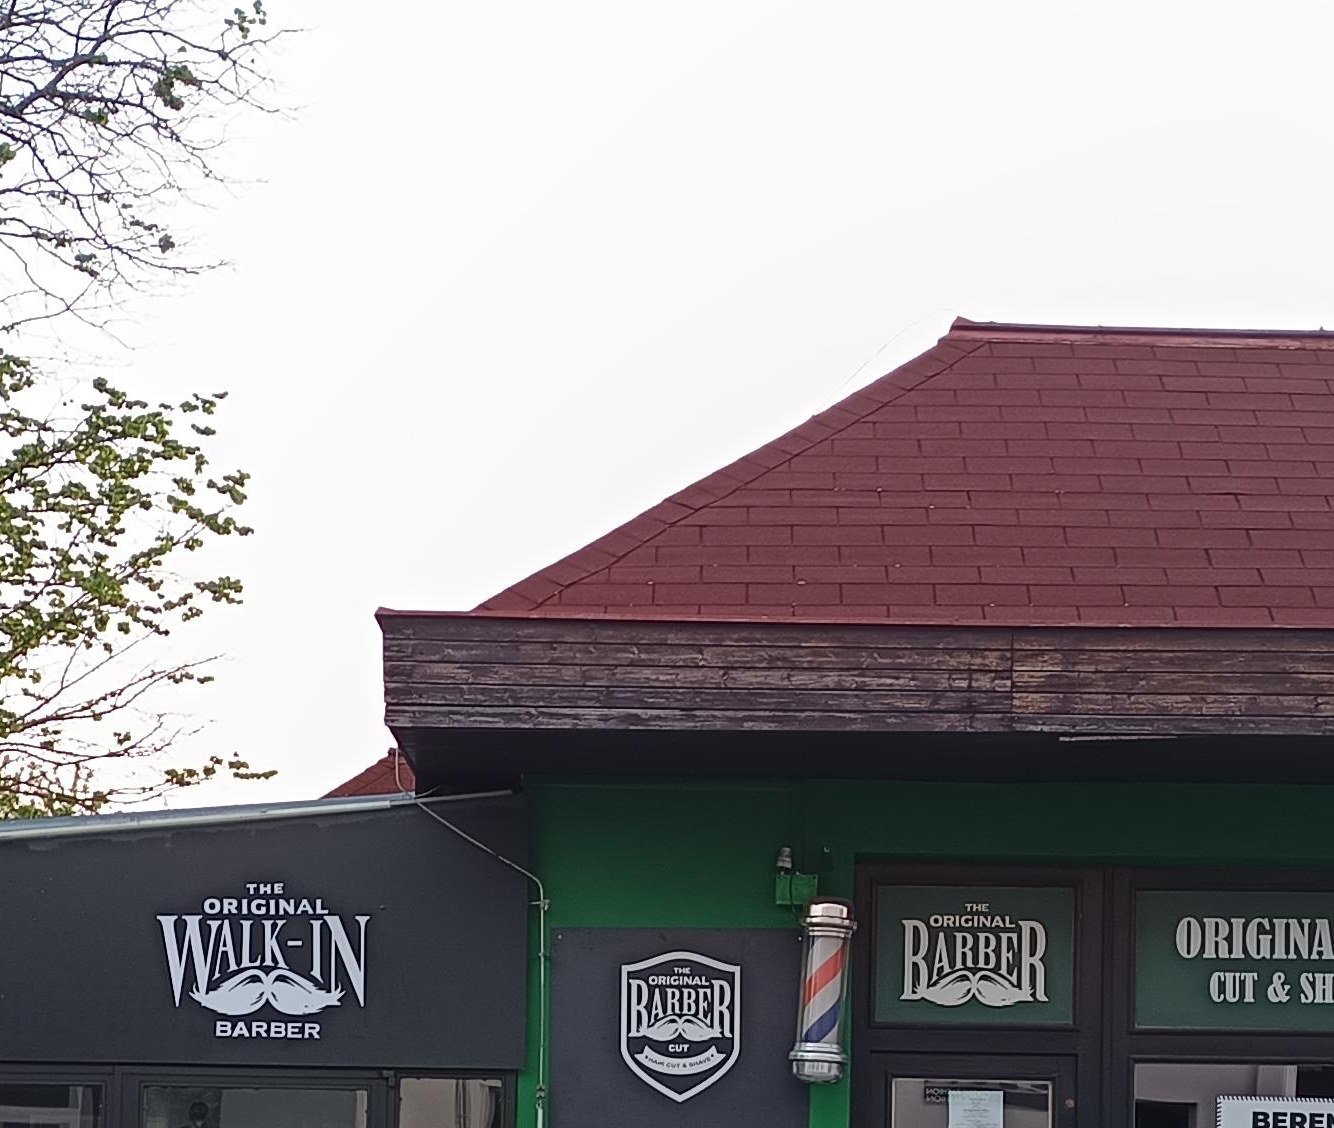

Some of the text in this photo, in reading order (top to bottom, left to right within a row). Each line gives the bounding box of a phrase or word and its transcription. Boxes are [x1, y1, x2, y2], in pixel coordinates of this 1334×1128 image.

[246, 883, 284, 894] THE
[203, 898, 329, 915] ORIGINAL
[965, 904, 989, 912] THE
[929, 914, 1015, 928] ORIGINAL
[157, 914, 370, 1008] WALK-IN
[899, 919, 1049, 1001] BARBER
[648, 975, 709, 986] ORIGINAL
[1209, 972, 1258, 1003] CUT
[1267, 972, 1291, 1003] &
[628, 979, 733, 1038] BARBER
[215, 1021, 321, 1039] BARBER
[668, 1044, 689, 1052] CUT
[689, 1057, 711, 1067] SHAVE
